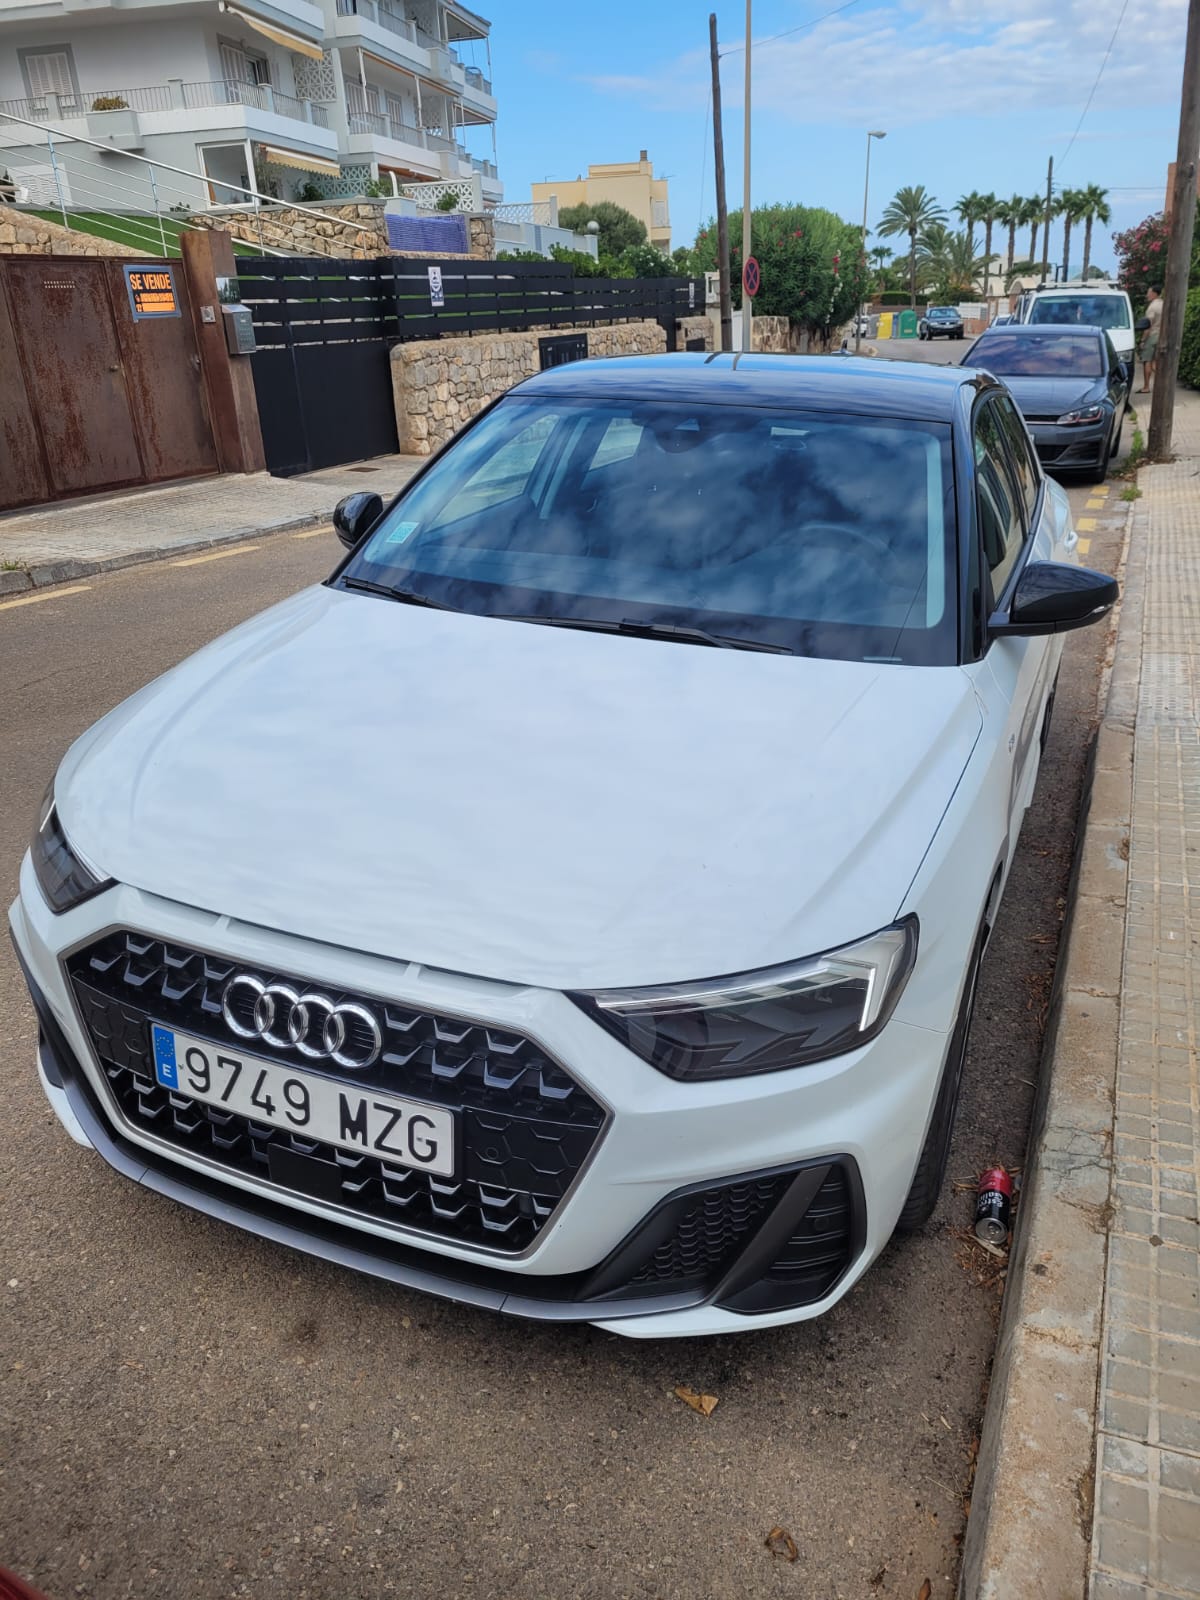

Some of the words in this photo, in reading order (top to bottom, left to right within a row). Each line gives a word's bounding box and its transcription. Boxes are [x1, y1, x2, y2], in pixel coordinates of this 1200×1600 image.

[129, 273, 143, 290] SE
[142, 273, 172, 290] VENDE
[162, 1063, 172, 1078] E
[185, 1047, 311, 1126] 9749
[339, 1092, 438, 1163] MZG
